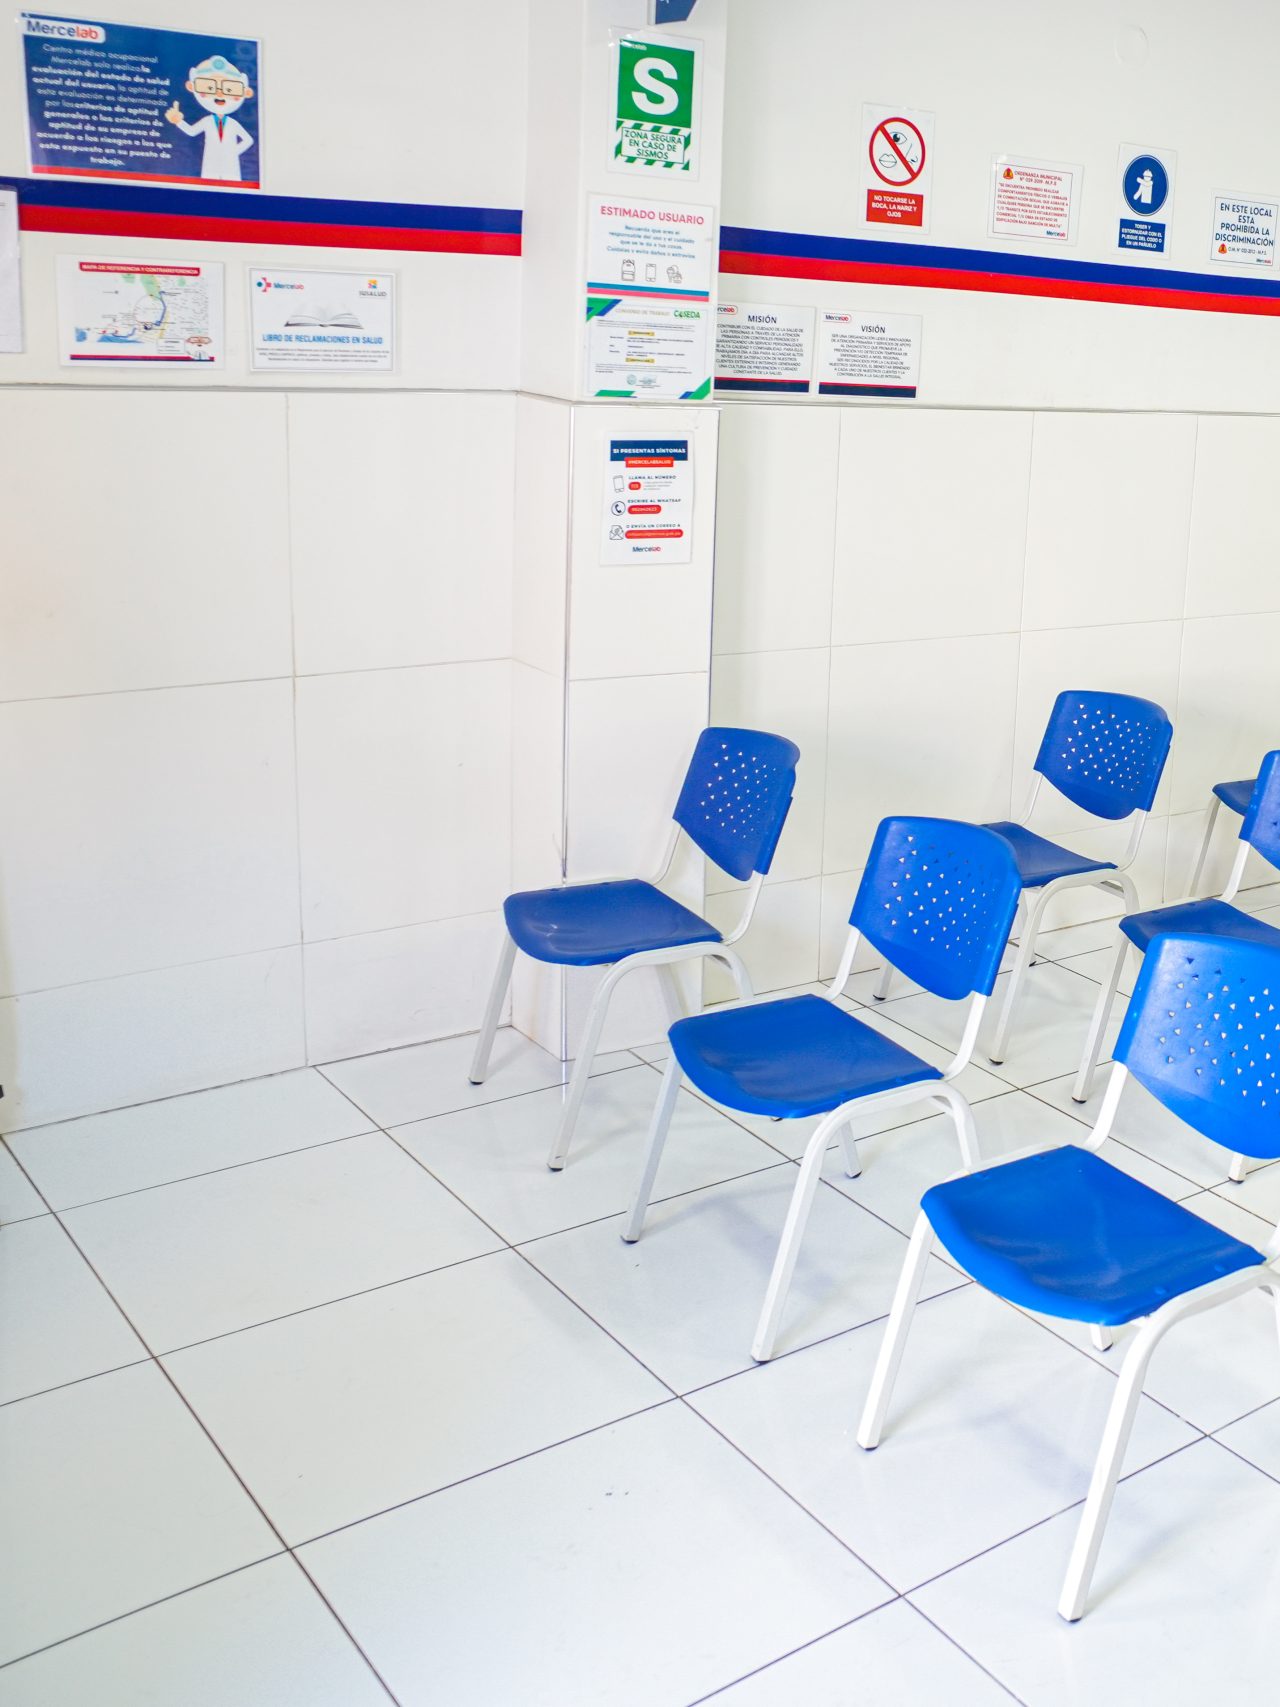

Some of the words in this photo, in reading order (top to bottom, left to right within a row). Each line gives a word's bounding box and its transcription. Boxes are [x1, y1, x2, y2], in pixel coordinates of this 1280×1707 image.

[27, 20, 99, 40] Mercelab
[32, 66, 84, 76] evaluación
[85, 69, 100, 78] del
[101, 73, 132, 81] estado
[133, 75, 145, 83] de
[147, 77, 170, 86] salud
[632, 57, 679, 116] S
[625, 130, 648, 139] ZONA
[651, 134, 682, 145] SEGURA
[642, 141, 665, 150] CASO
[667, 144, 677, 152] DE
[637, 149, 669, 160] SISMOS
[601, 206, 656, 220] ESTIMADO
[659, 212, 705, 225] USUARIO
[1221, 203, 1230, 211] EN
[1232, 204, 1248, 214] ESTE
[1250, 207, 1272, 217] LOCAL
[1238, 215, 1254, 224] ESTA
[1221, 223, 1260, 234] PROHIBIDA
[1262, 228, 1270, 236] LA
[1215, 233, 1274, 246] DISCRIMINACIÓN
[748, 315, 777, 323] MISIÓN
[861, 325, 886, 333] VISIÓN
[263, 334, 283, 342] LIBRO
[295, 335, 350, 343] RECLAMACIONES
